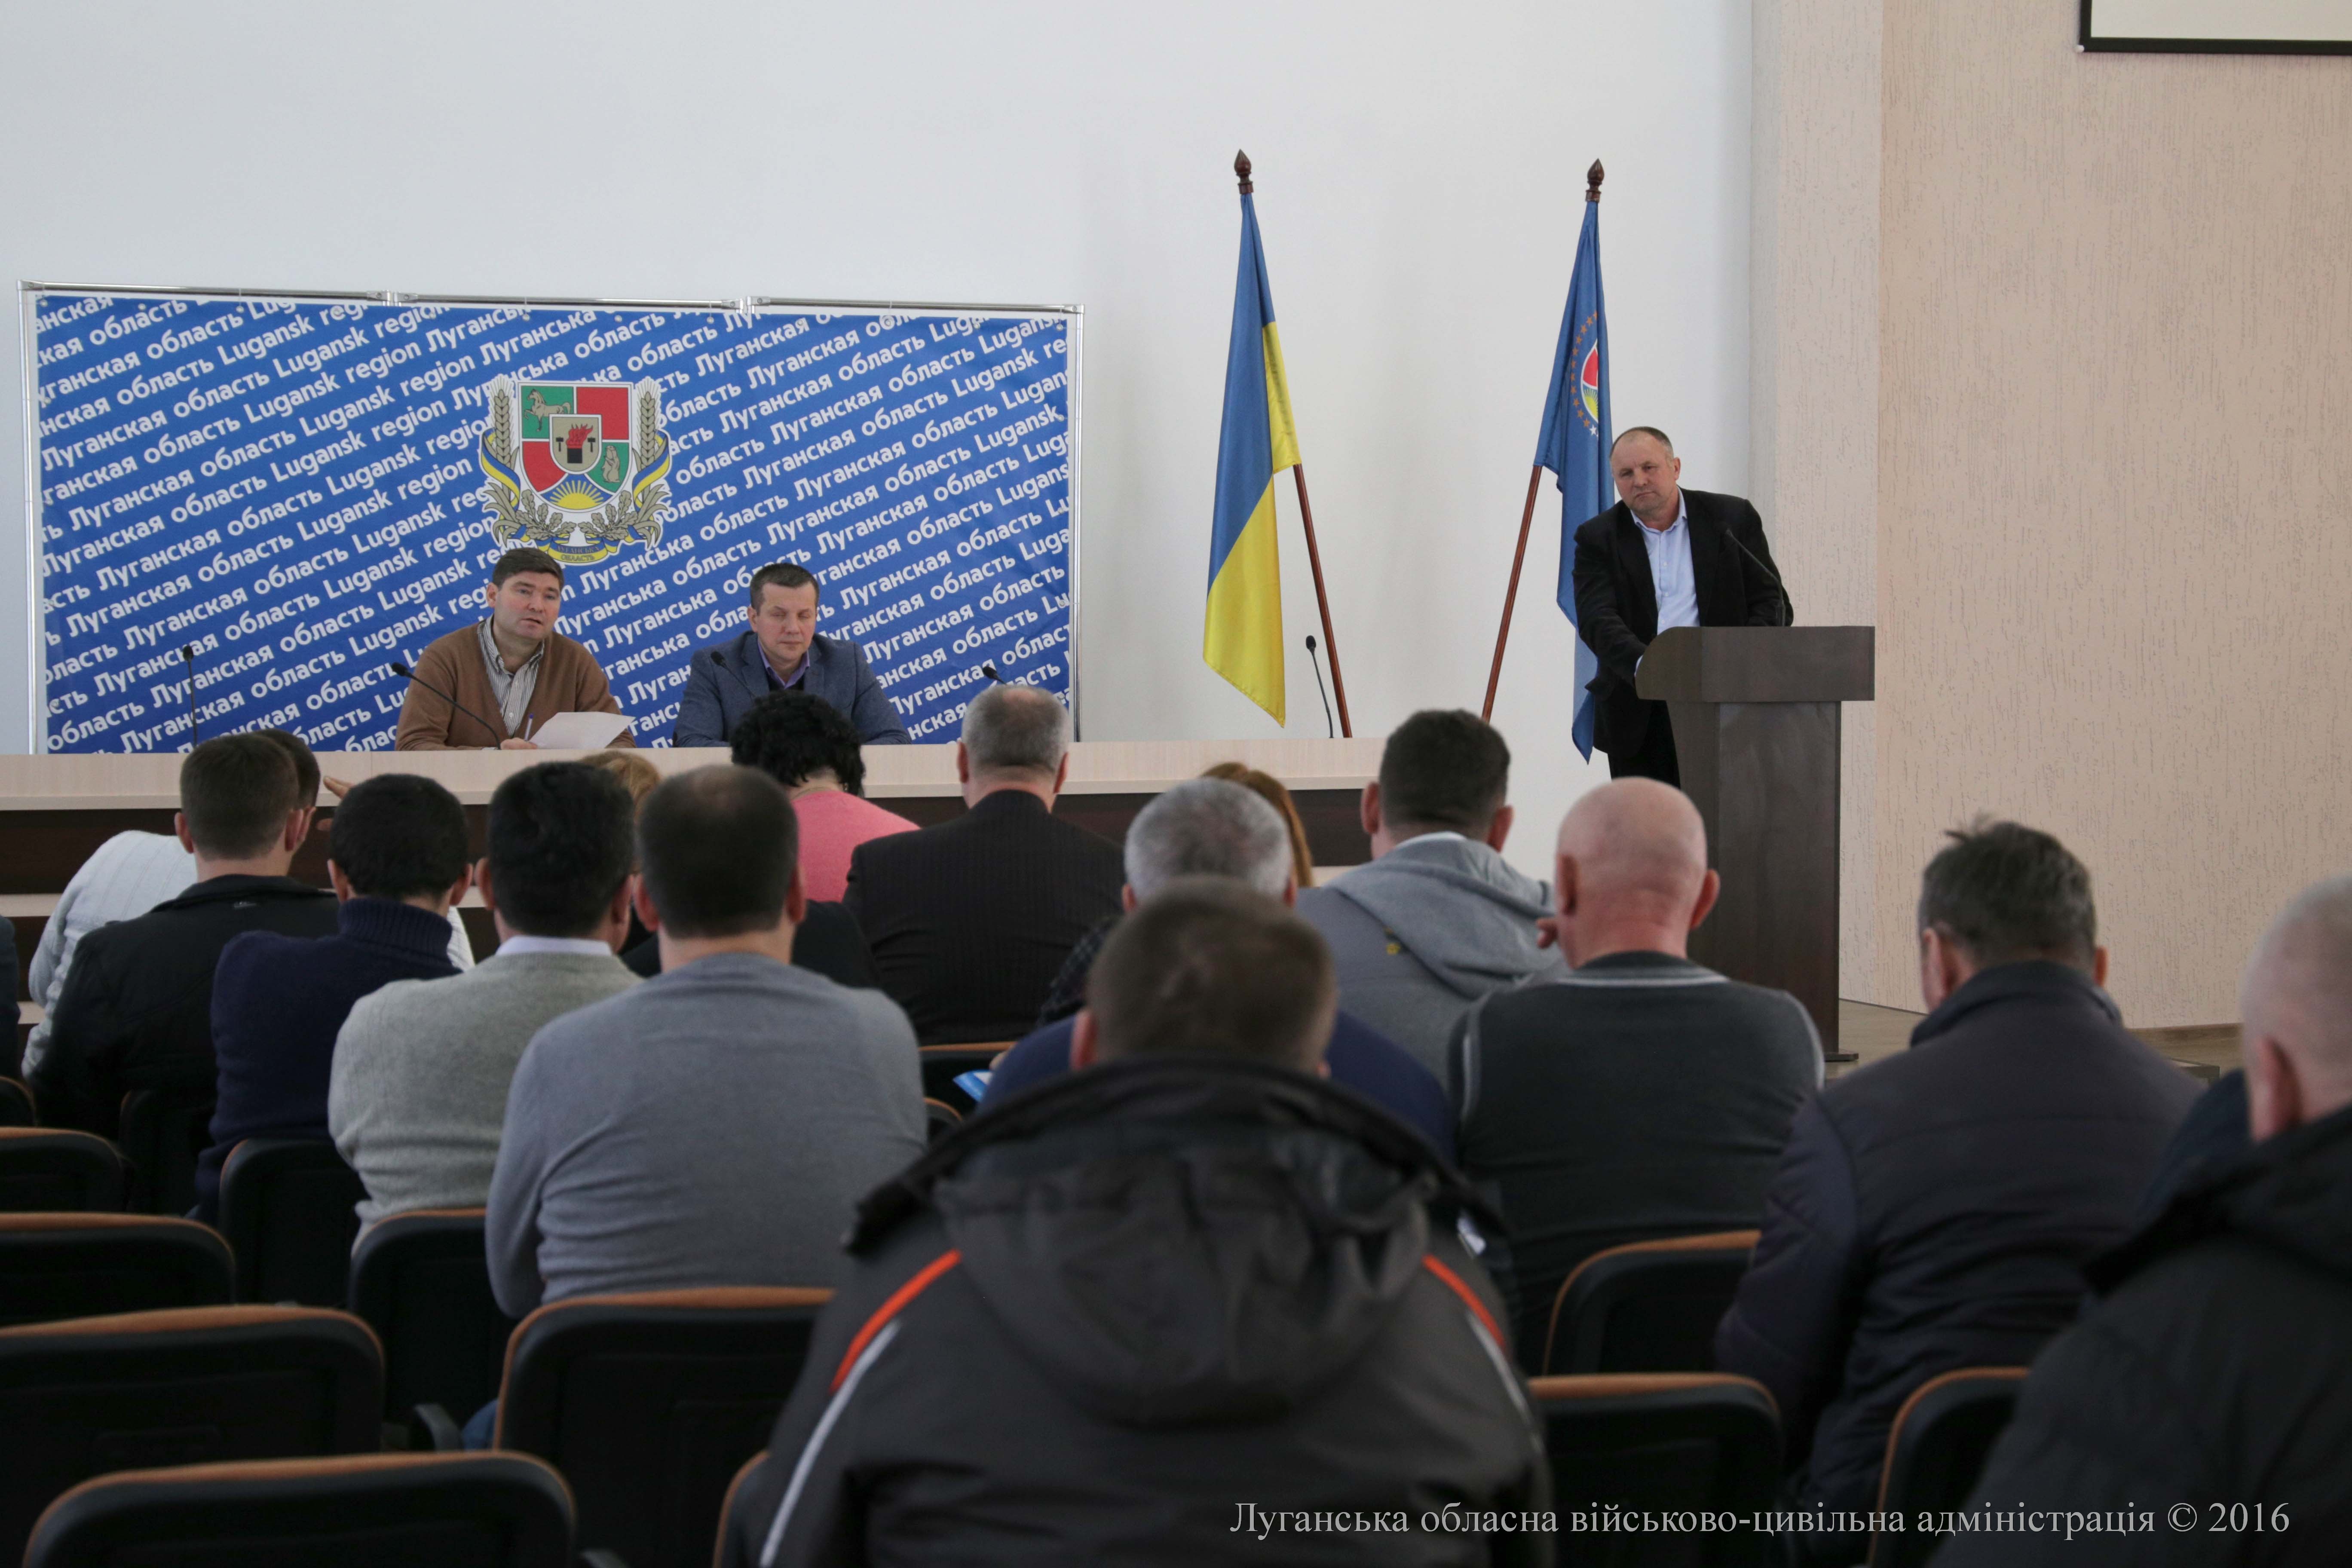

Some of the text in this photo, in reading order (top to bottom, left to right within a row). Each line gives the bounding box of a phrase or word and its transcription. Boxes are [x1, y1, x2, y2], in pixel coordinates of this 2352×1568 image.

[38, 300, 187, 368] кая область
[40, 305, 368, 438] нская область Lugansk reg
[42, 410, 168, 471] Луганская
[173, 372, 270, 417] область
[273, 327, 370, 378] Lugansk
[43, 309, 532, 505] ганская область Lugansk region Лугансь
[68, 469, 194, 531] Луганская
[200, 431, 296, 477] область
[299, 385, 395, 437] Lugansk
[400, 355, 475, 396] region
[479, 311, 597, 365] Луганська
[147, 313, 243, 359] область
[44, 515, 165, 577] Луганская
[171, 476, 267, 522] область
[270, 430, 367, 482] Lugansk
[371, 400, 447, 441] region
[574, 313, 665, 358] область
[46, 644, 118, 684] ласть
[123, 588, 248, 650] Луганская
[254, 548, 349, 594] область
[352, 502, 447, 554] Lugansk
[659, 383, 741, 428] бласть
[747, 330, 860, 389] Луганская
[865, 316, 916, 337] обл
[47, 691, 88, 718] сть
[94, 634, 219, 696] Лугансая
[225, 594, 320, 640] область
[323, 547, 418, 599] Lugansk
[669, 427, 714, 456] асть
[719, 374, 833, 433] Луганская
[838, 336, 925, 381] область
[929, 318, 988, 342] Lug
[48, 320, 1059, 750] область Луганская область Lugansk область Луганская область Lugans
[66, 318, 810, 637] Луганская область Lugansk region Луганская
[96, 529, 221, 591] Луганская
[227, 490, 323, 536] область
[325, 444, 421, 496] Lugansk
[627, 316, 718, 371] область
[723, 314, 761, 332] Лу
[121, 691, 245, 753] Луганская
[251, 651, 346, 698] область
[349, 603, 444, 656] Lugansk
[448, 580, 489, 614] reg
[742, 429, 856, 489] Луганская
[861, 392, 949, 436] область
[951, 348, 1039, 397] Lugansk
[1043, 331, 1069, 358] re
[306, 663, 397, 710] област
[579, 533, 695, 594] Луганська
[700, 495, 789, 541] область
[793, 441, 906, 501] Луганская
[912, 404, 998, 448] область
[1000, 370, 1069, 410] Lugan
[603, 588, 717, 648] Луганська
[816, 494, 928, 554] Луганская
[934, 457, 1020, 502] область
[1022, 425, 1069, 463] Lug
[293, 403, 1065, 745] бласть Луганська область Луганская область Lugansk
[600, 456, 1069, 680] ганська обла ганская область Lugans
[628, 665, 691, 704] Луган
[840, 550, 952, 610] Луганская
[956, 512, 1042, 557] область
[863, 566, 1065, 664] Луганская область
[878, 593, 1069, 689] анская область Lu
[930, 555, 1016, 600] область
[1002, 624, 1069, 665] облас
[907, 702, 970, 740] нская
